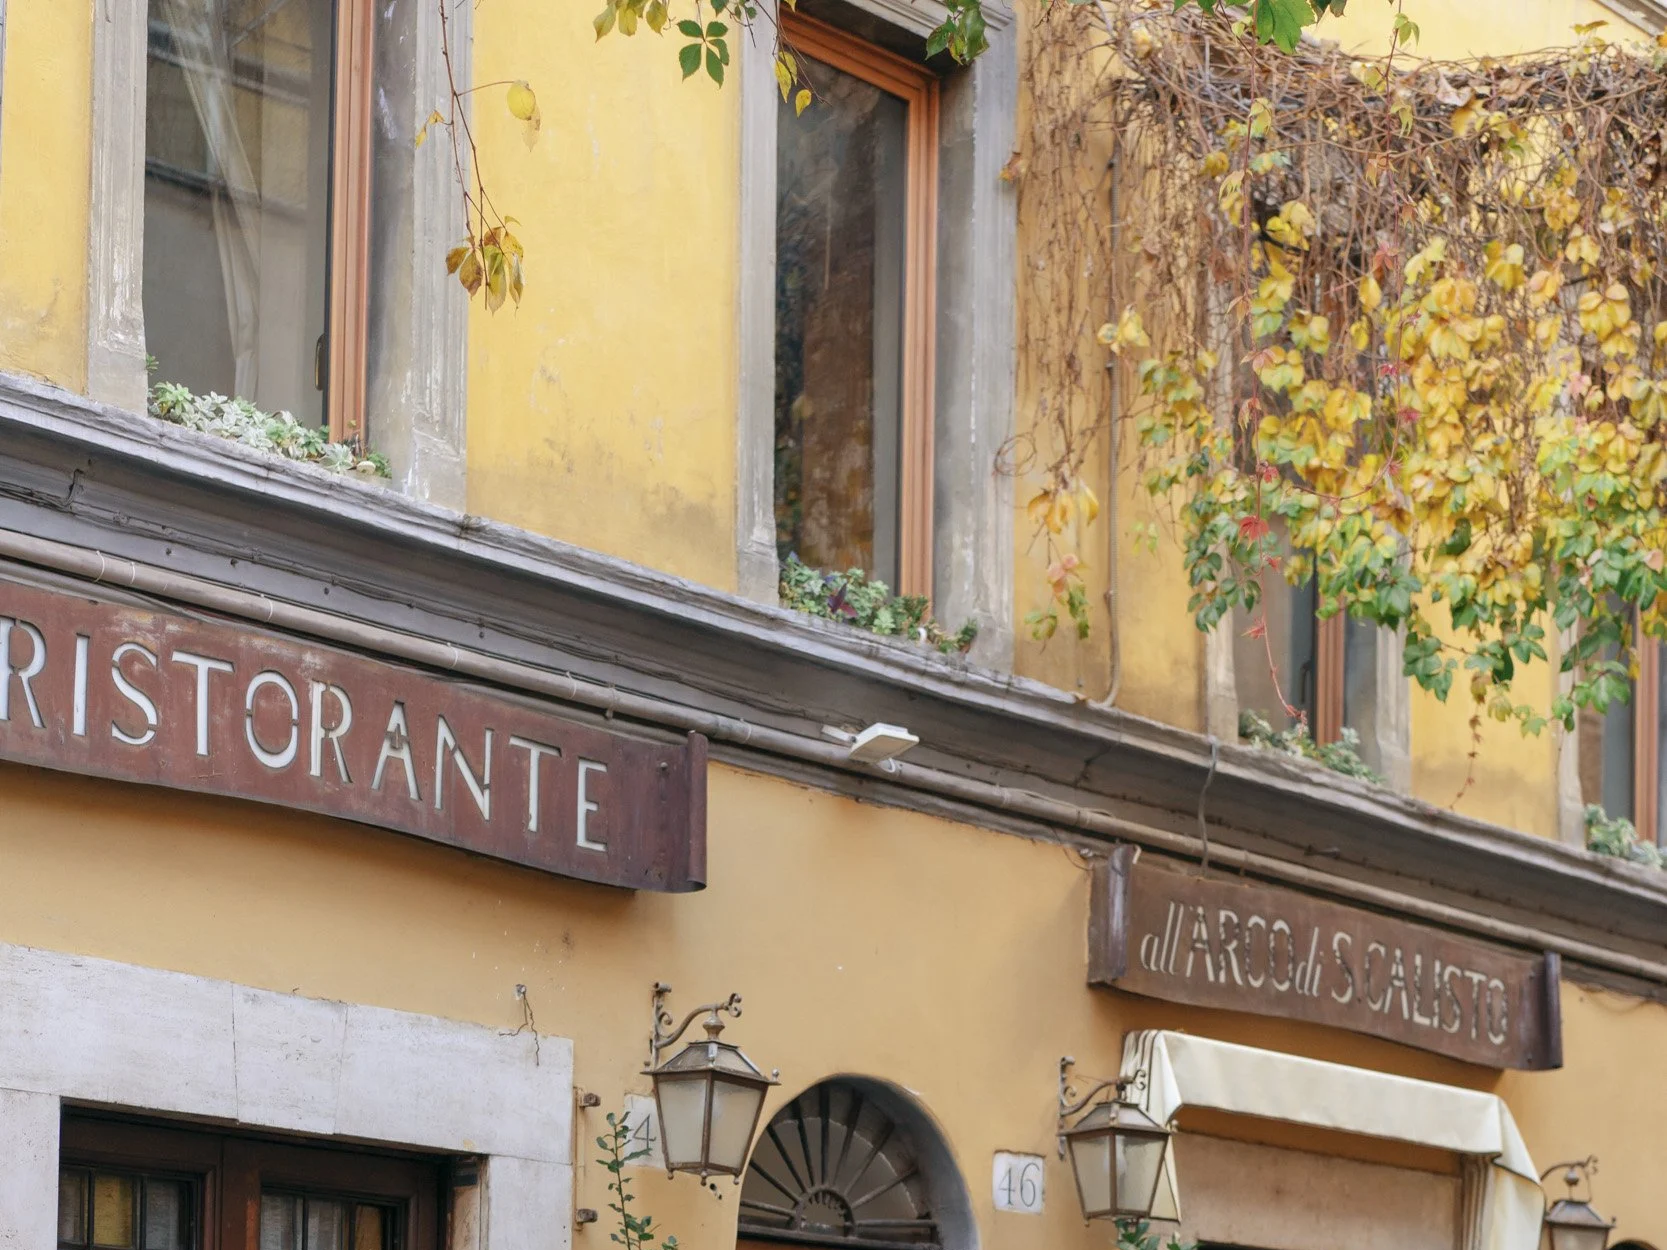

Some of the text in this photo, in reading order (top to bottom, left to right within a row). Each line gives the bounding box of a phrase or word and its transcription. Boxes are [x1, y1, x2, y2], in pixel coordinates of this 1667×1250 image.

[0, 614, 609, 853] RISTORANTE
[1295, 926, 1325, 997] di
[998, 1162, 1041, 1208] 46
